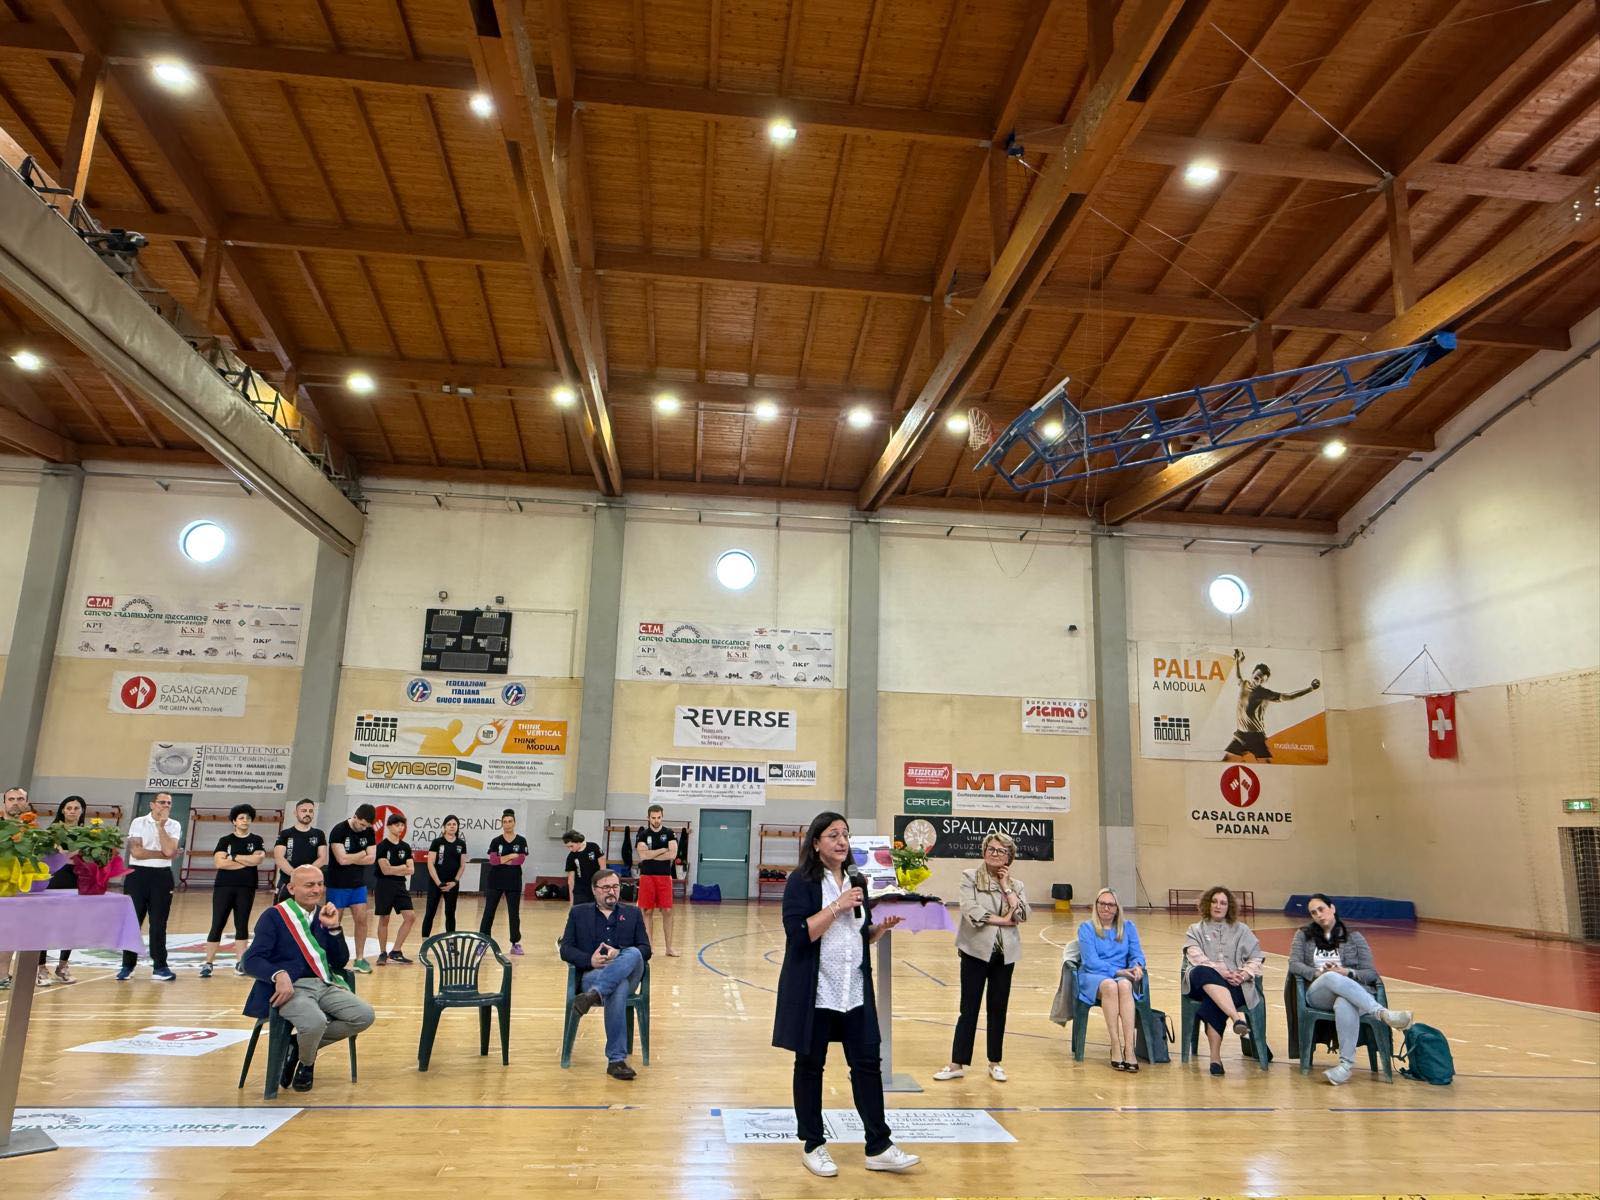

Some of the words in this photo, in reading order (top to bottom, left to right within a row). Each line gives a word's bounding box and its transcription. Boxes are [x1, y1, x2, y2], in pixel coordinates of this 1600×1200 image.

[87, 597, 112, 608] C.T.M.
[640, 624, 663, 634] C.T.M.
[1153, 658, 1225, 681] PALLA
[161, 685, 238, 696] CASALGRANDE
[1152, 680, 1160, 690] A
[1164, 681, 1206, 693] MODULA
[160, 694, 202, 704] PADANA
[682, 708, 790, 728] REVERSE
[355, 728, 397, 742] MODULA
[1154, 728, 1190, 741] MODULA
[1273, 742, 1314, 750] modula.com
[191, 760, 201, 788] DESIGN
[372, 761, 451, 779] syneco
[682, 766, 765, 782] FINEDIL
[784, 770, 816, 778] CORRADINI
[149, 778, 189, 788] PROJECT
[957, 773, 1066, 792] MAP
[906, 798, 950, 806] CERTECH
[1192, 810, 1292, 823] CASALGRANDE
[942, 820, 1046, 836] SPALLANZANI
[1216, 824, 1269, 835] PADANA
